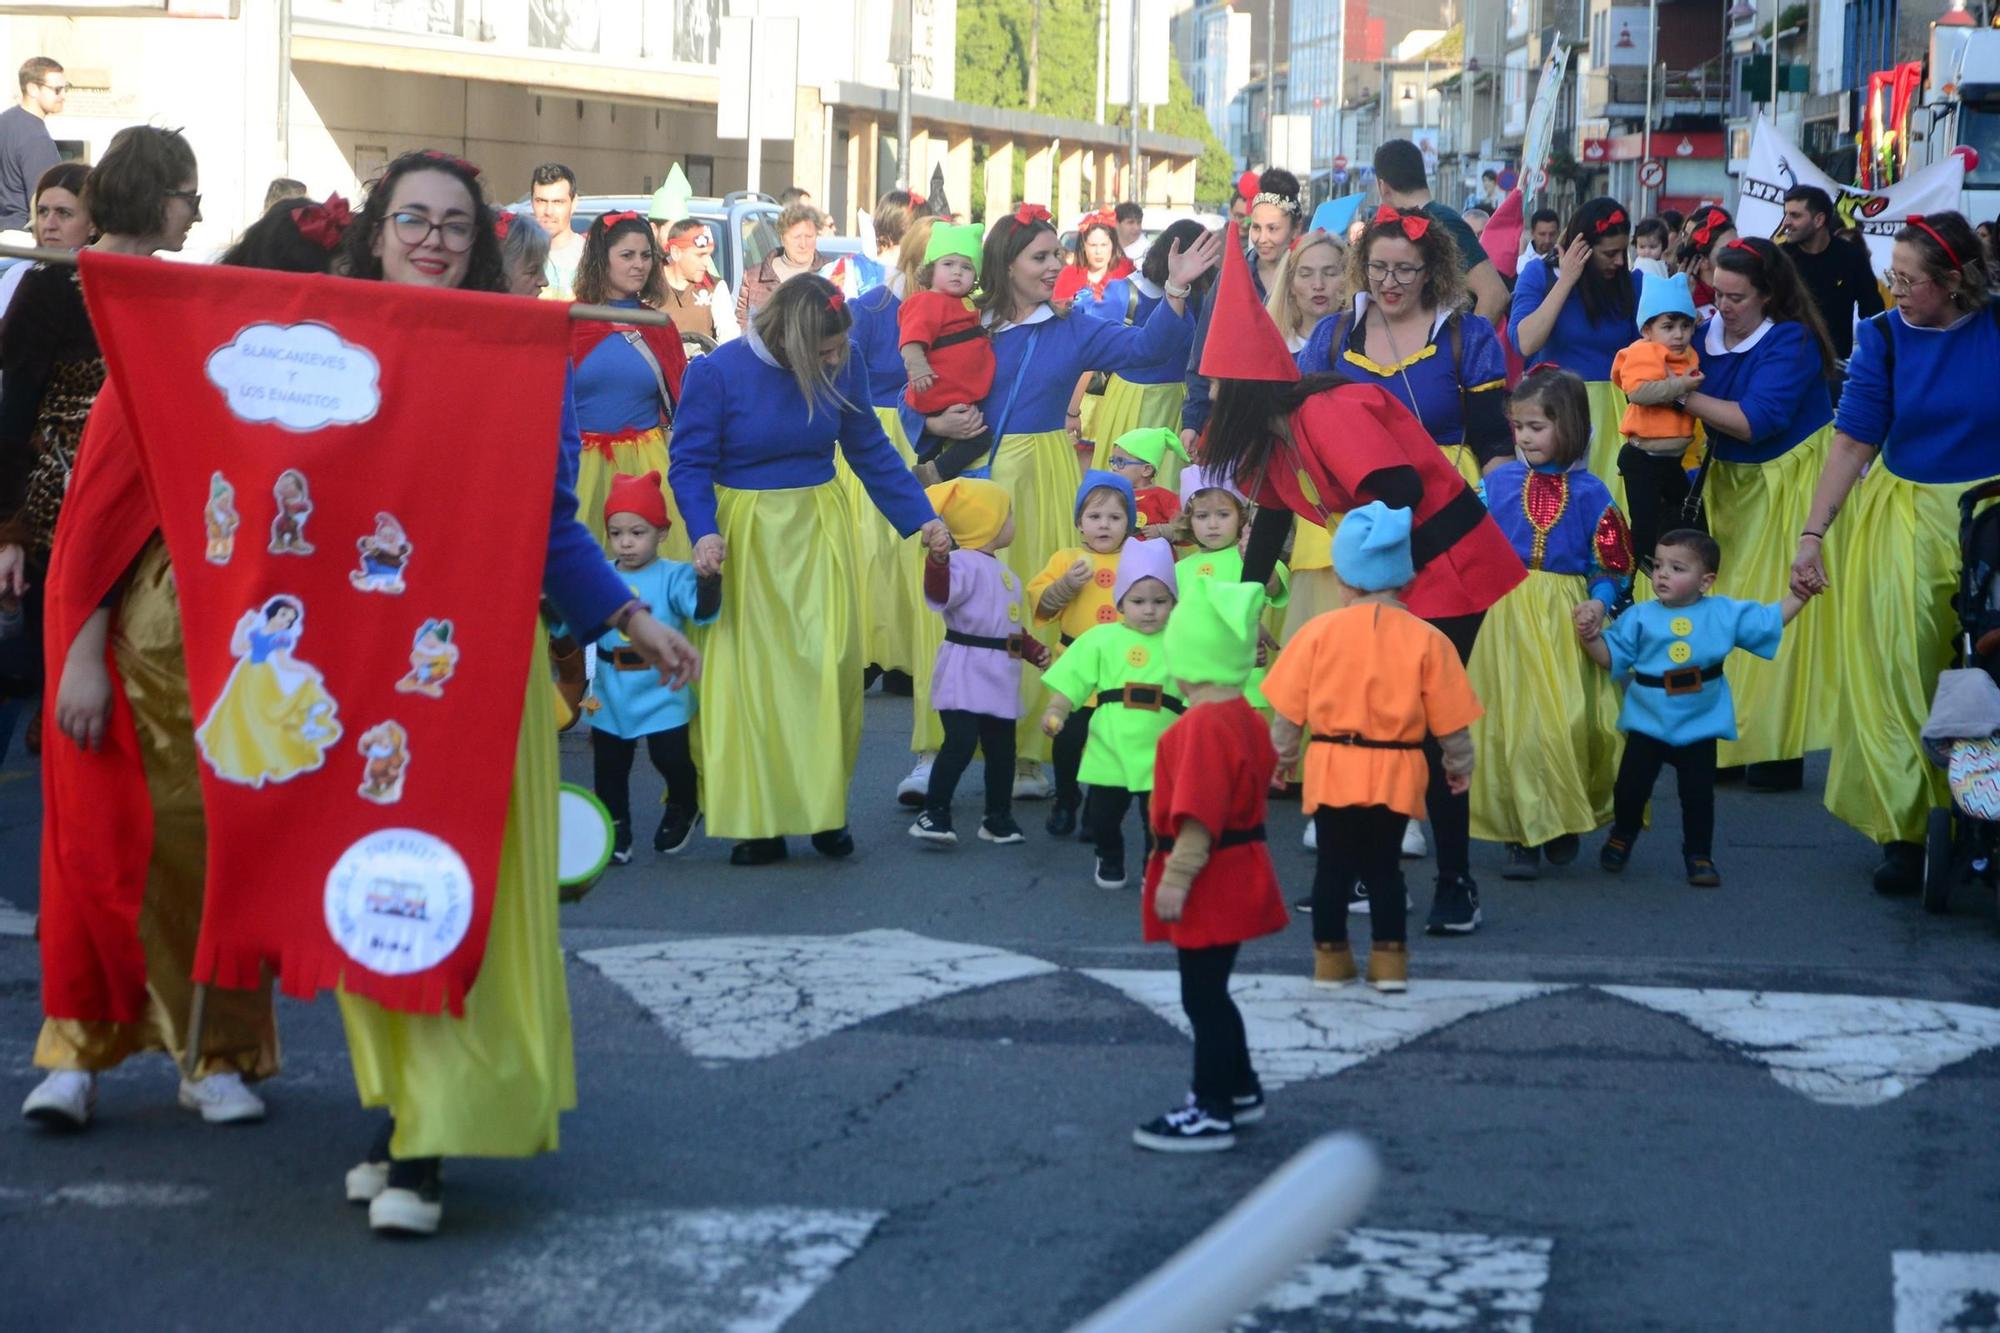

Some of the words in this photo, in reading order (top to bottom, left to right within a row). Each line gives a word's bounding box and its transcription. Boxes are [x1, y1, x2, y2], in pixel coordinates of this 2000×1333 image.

[242, 343, 347, 371] BLANCANIEVES
[287, 369, 299, 383] Y
[240, 384, 265, 400] LOS
[269, 387, 341, 410] ENANITOS
